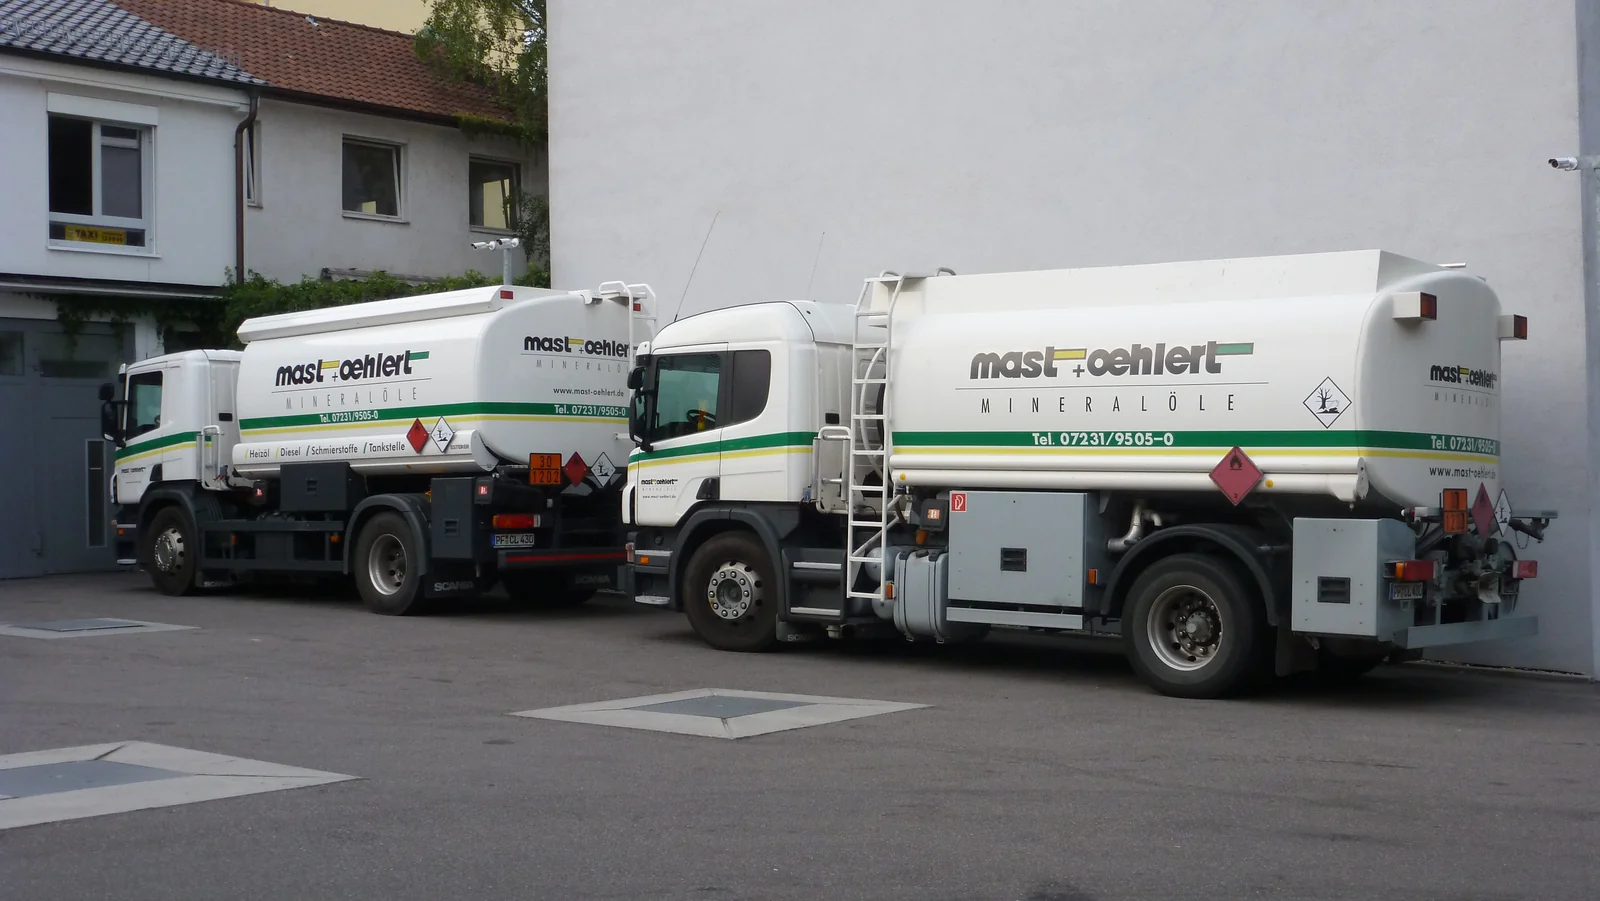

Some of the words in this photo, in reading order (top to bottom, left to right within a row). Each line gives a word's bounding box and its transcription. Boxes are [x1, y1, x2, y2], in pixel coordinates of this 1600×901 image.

[75, 229, 98, 240] TAXI
[286, 387, 417, 409] MINERALÖLE
[553, 387, 624, 397] www.mast-oehlert.de
[981, 391, 1234, 413] MINERALÖLE
[319, 414, 331, 423] Tel.
[331, 410, 379, 423] 07231/9505-0
[554, 404, 569, 414] Tel.
[572, 405, 626, 417] 07231/9505-0
[1032, 432, 1055, 446] Tel.
[1060, 432, 1174, 446] 07231/9505-0
[1431, 436, 1447, 450] Tel.
[1450, 437, 1496, 455] 07231/9505-0
[249, 449, 270, 459] Heizöl
[280, 447, 301, 457] Diesel
[311, 444, 358, 456] Schmierstoffe
[369, 442, 405, 453] Tankstelle
[540, 455, 552, 468] 30
[532, 470, 559, 483] 1202
[495, 535, 505, 545] PF
[510, 535, 519, 545] CL
[520, 534, 533, 544] 430
